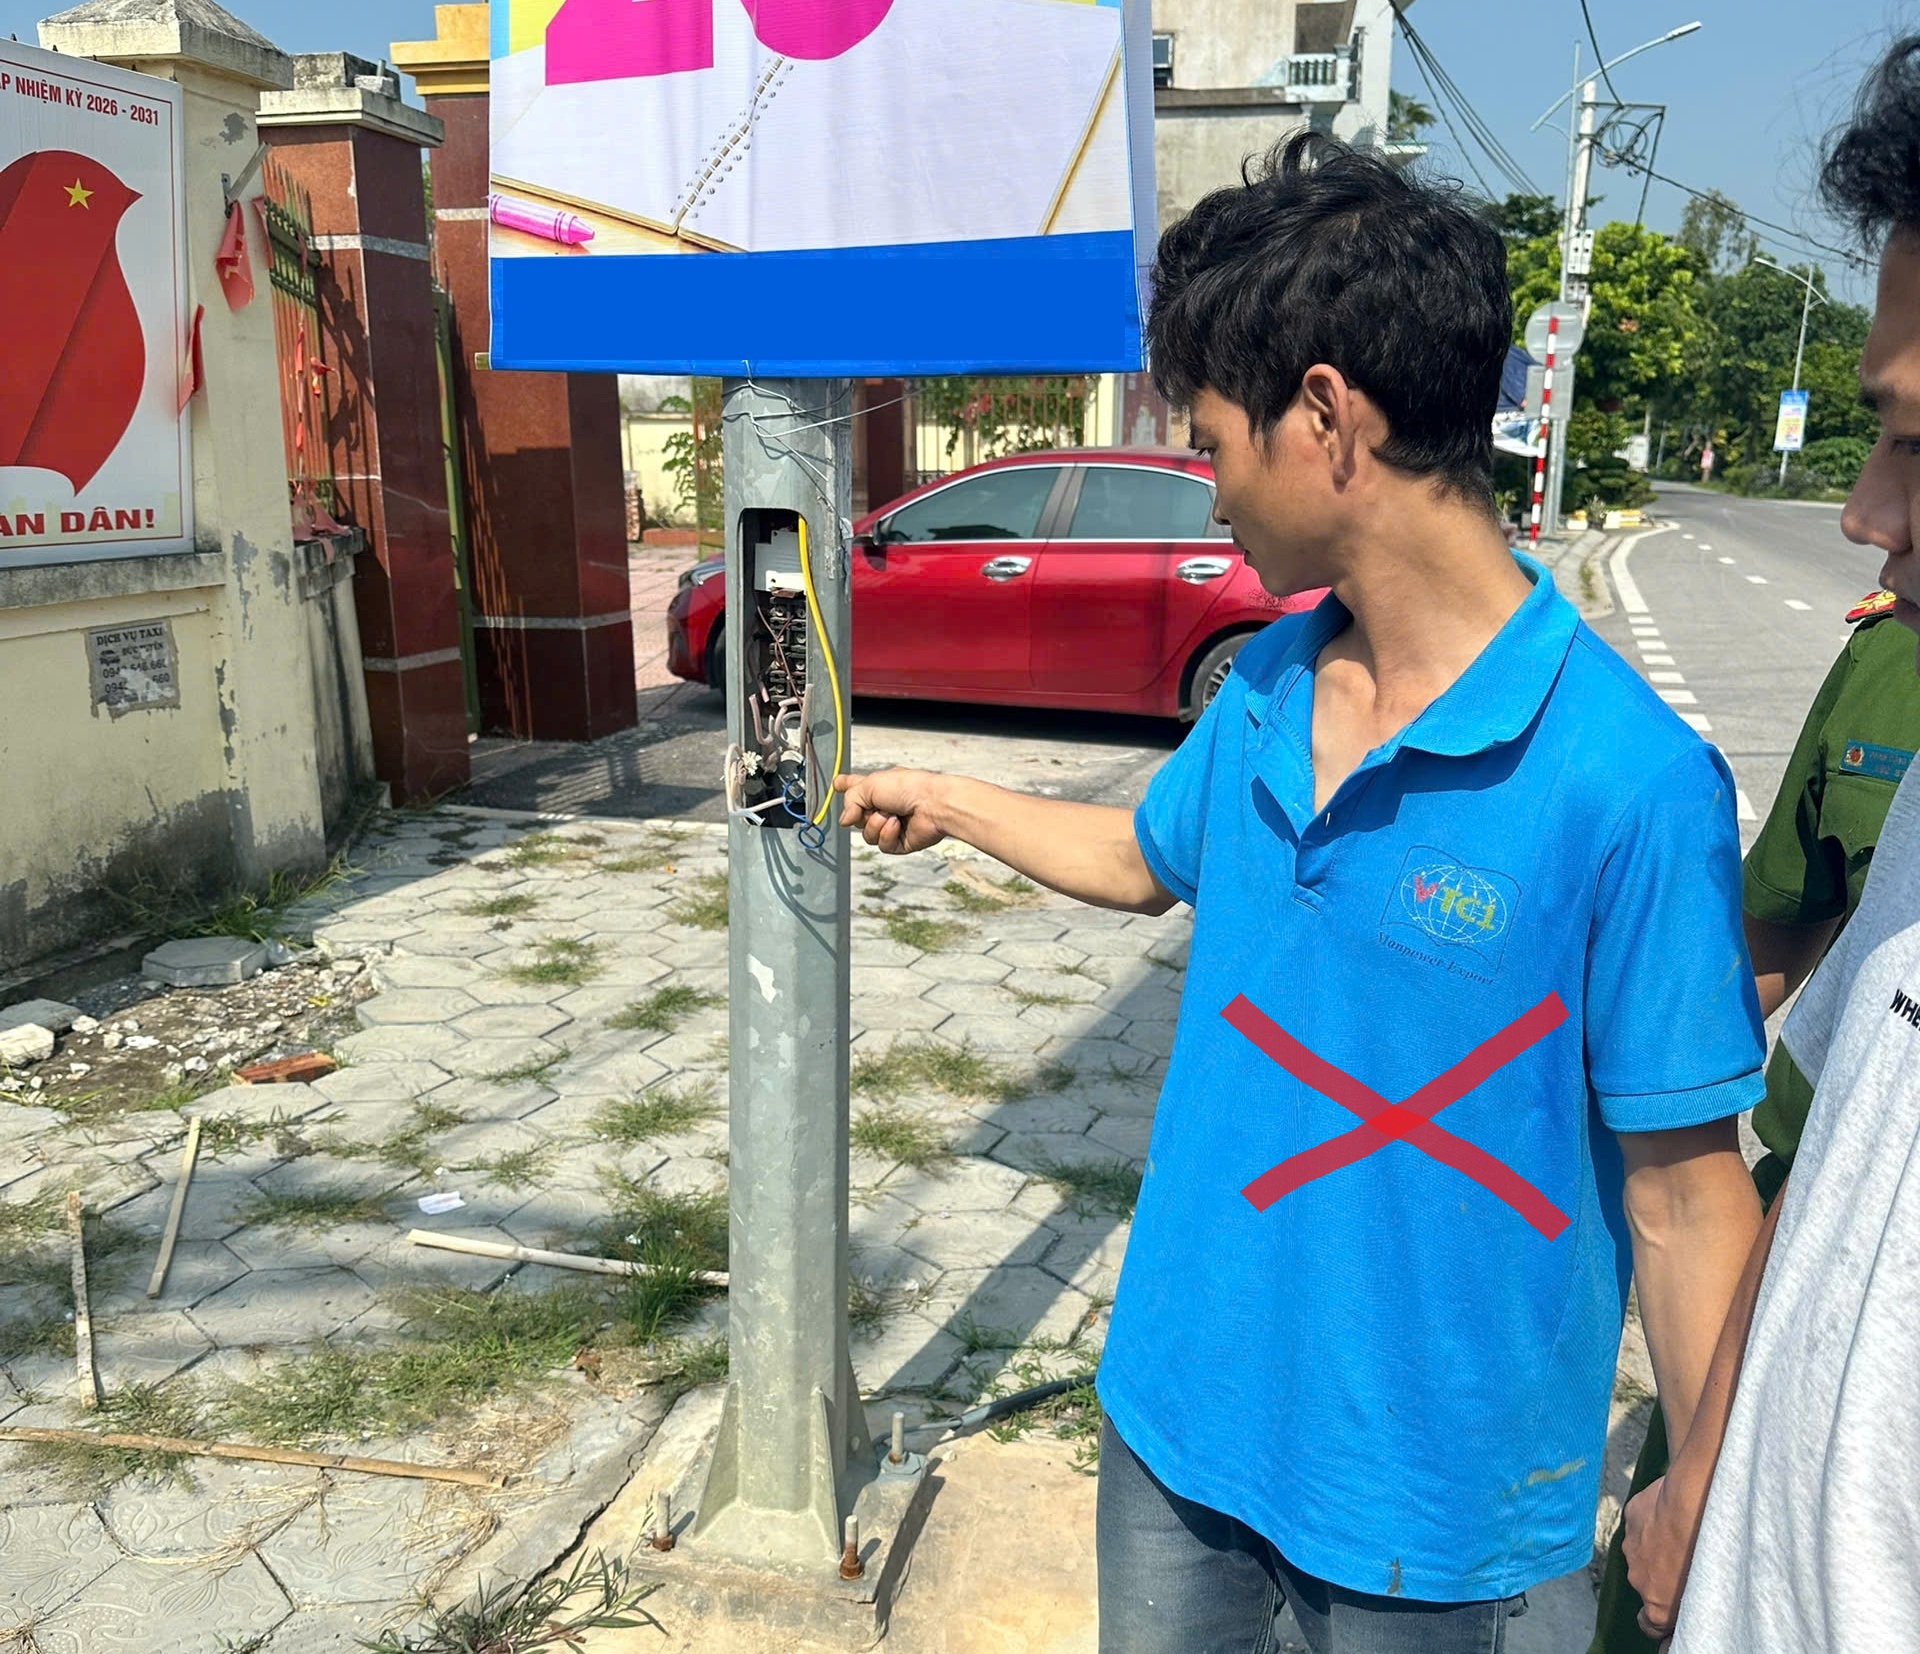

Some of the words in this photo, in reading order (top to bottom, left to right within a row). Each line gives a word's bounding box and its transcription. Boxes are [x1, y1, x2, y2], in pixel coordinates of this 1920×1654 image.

[0, 72, 11, 90] P
[15, 76, 61, 104] NHIỆM
[65, 87, 83, 109] KỲ
[86, 95, 118, 116] 2026
[130, 105, 159, 126] 2031
[60, 506, 155, 533] DÂN!
[96, 633, 121, 647] DỊCH
[122, 630, 137, 642] VỤ
[139, 627, 163, 638] TAXI
[1377, 931, 1442, 967] Manpower
[1446, 960, 1496, 985] Export
[1889, 988, 1920, 1031] WHE
